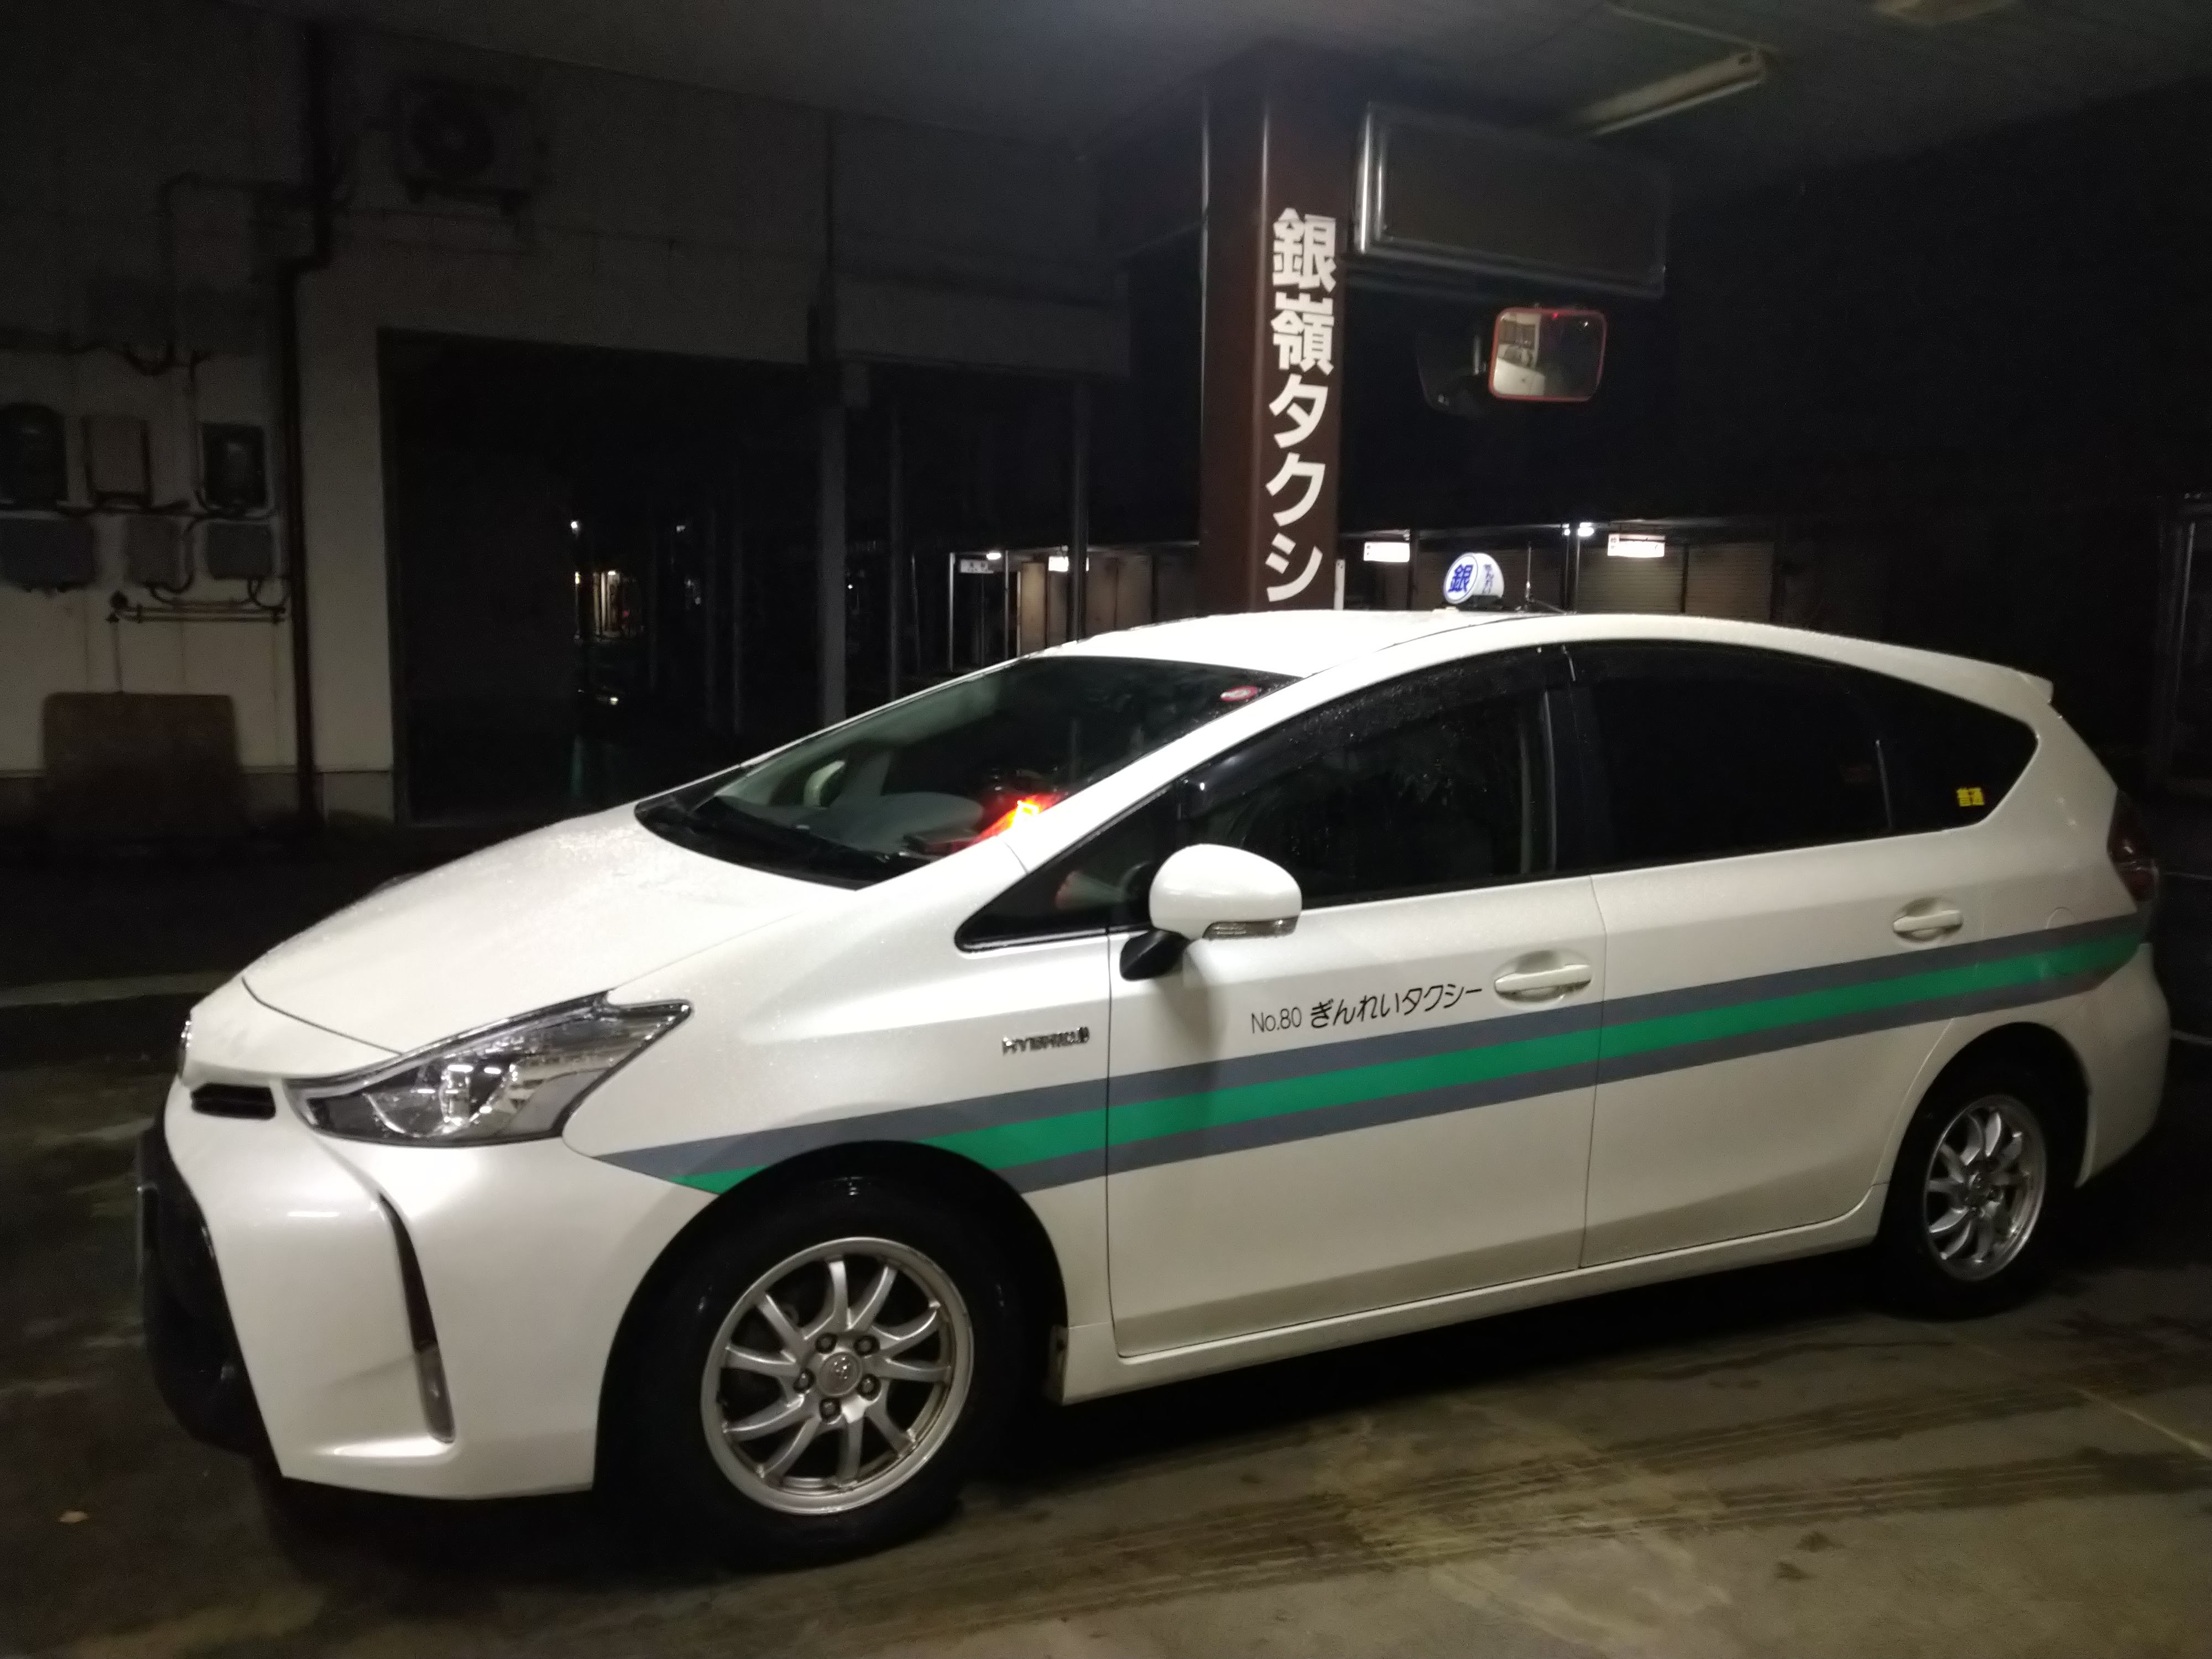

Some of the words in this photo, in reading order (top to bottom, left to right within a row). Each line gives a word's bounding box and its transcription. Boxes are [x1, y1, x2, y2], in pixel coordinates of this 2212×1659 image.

[1265, 207, 1336, 603] 銀嶺タクシ
[1448, 564, 1474, 593] 銀
[1251, 1006, 1302, 1034] No.80
[1310, 983, 1483, 1029] ぎんれいタクシー
